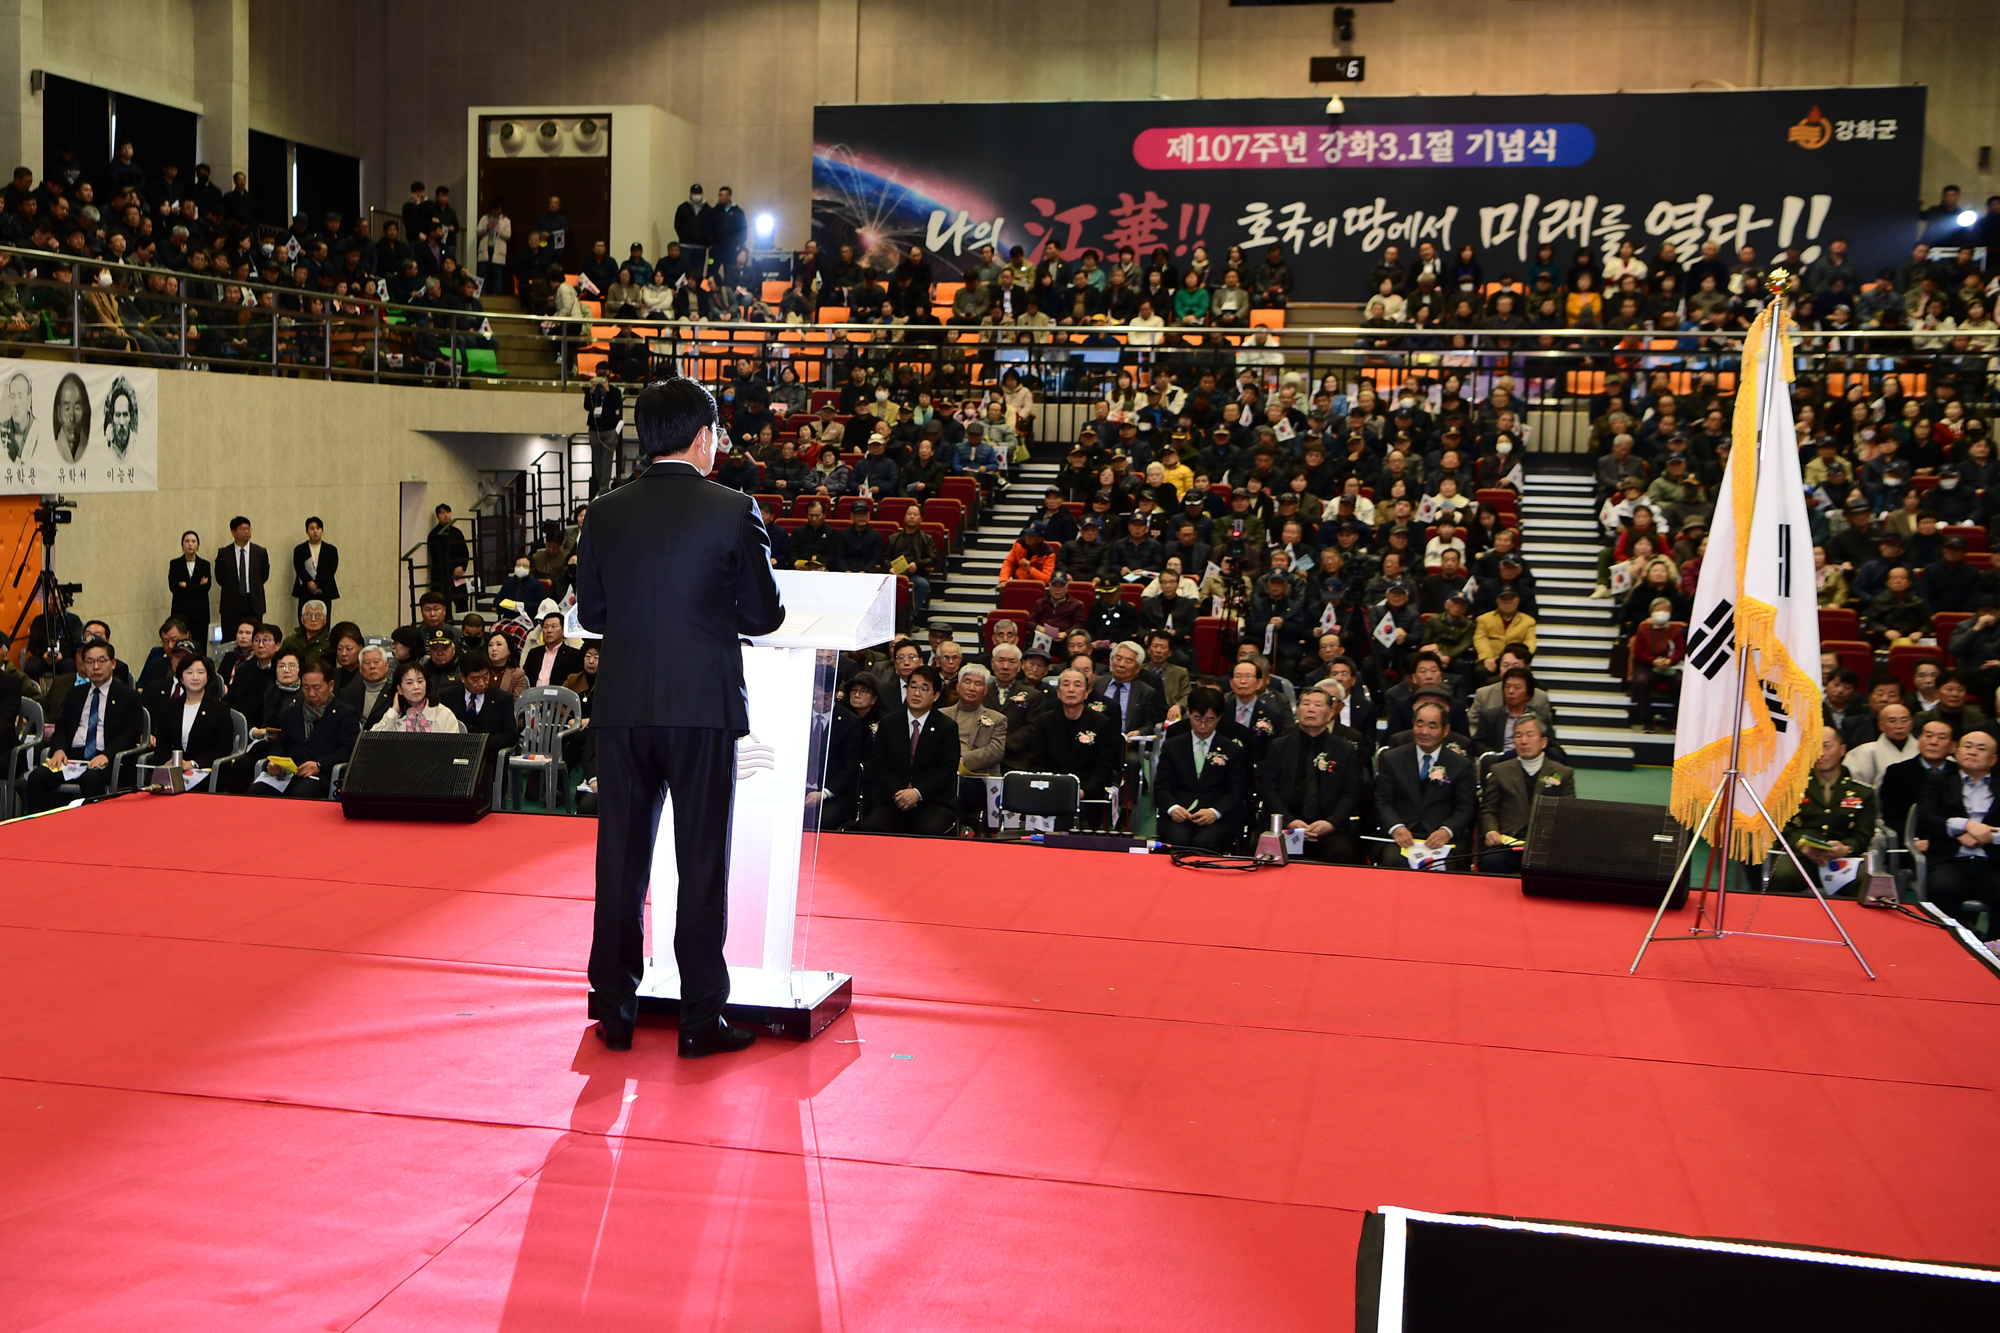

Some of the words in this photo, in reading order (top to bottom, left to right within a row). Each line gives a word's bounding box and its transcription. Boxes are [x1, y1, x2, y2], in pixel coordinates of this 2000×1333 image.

[1166, 131, 1308, 164] 제107주년
[1317, 129, 1454, 164] 강화3.1절
[1466, 128, 1558, 163] 기념식
[1835, 118, 1898, 141] 강화군
[925, 209, 1005, 257] 나의
[1236, 201, 1338, 255] 호국의
[1342, 196, 1459, 253] 땅에서
[1478, 193, 1634, 265] 미래를
